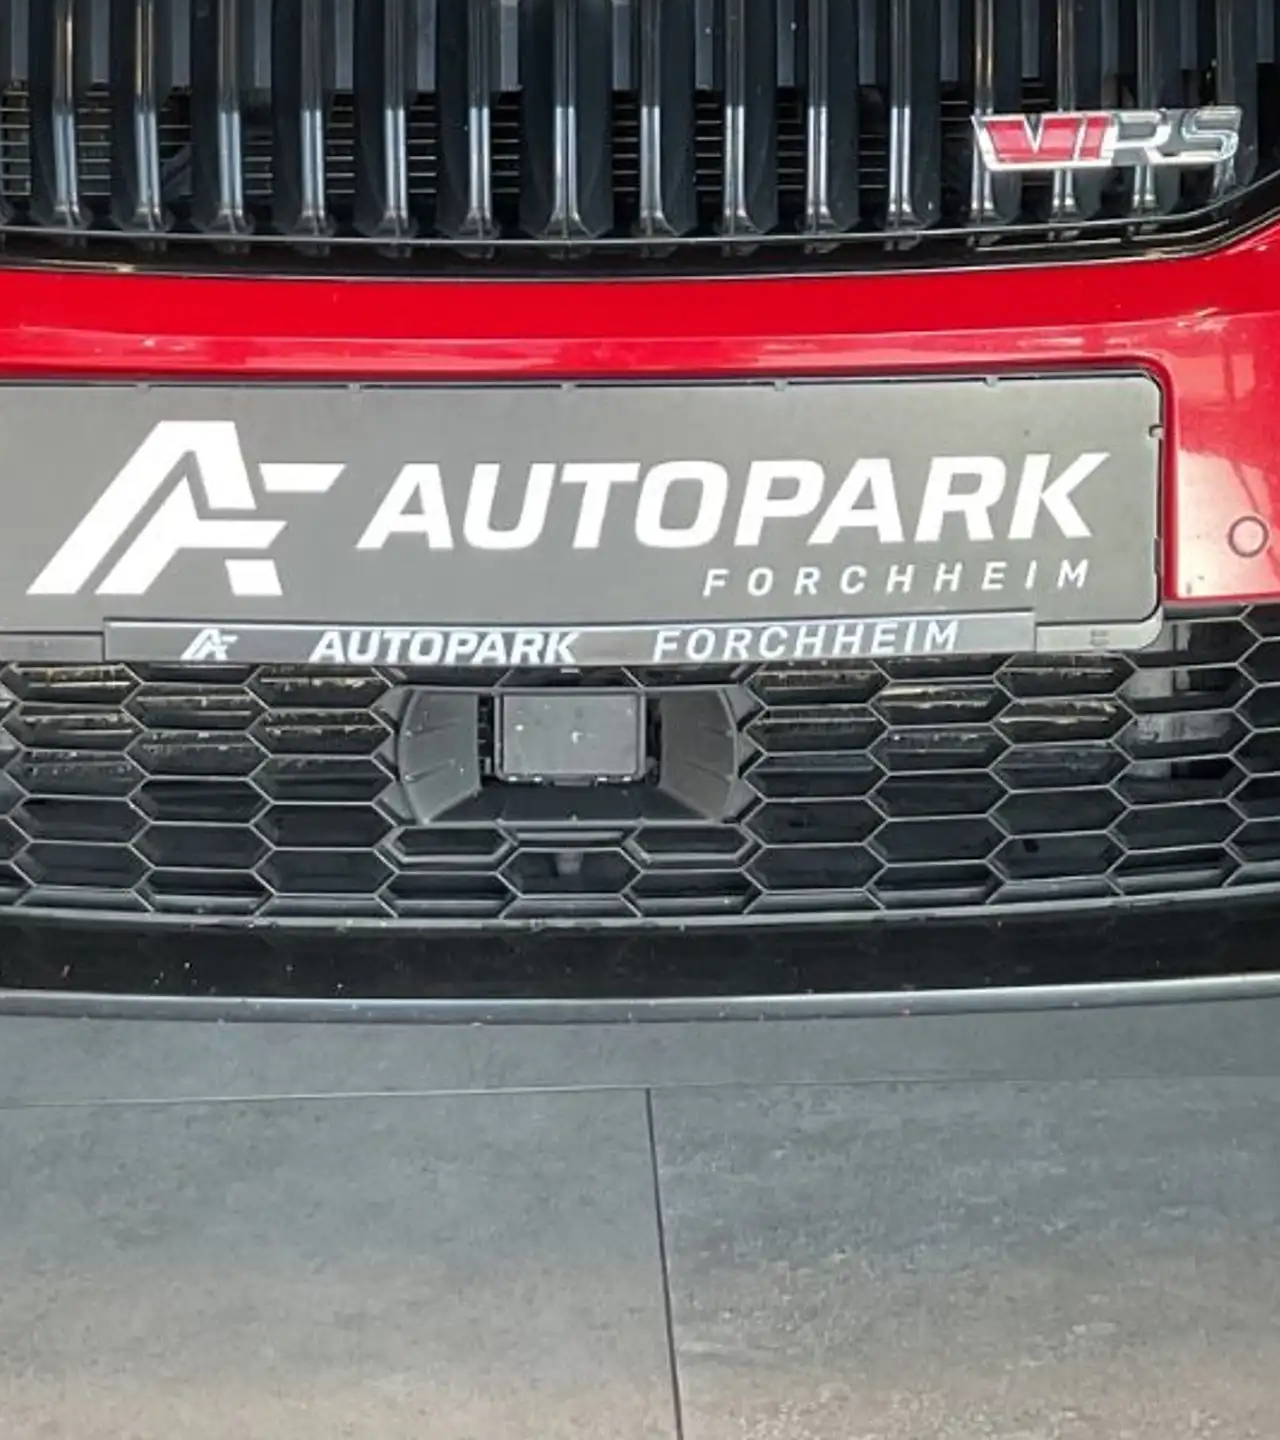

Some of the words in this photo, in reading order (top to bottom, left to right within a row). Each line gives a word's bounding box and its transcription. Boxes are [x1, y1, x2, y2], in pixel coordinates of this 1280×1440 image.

[354, 450, 1111, 551] AUTOPARK
[701, 557, 1092, 599] FORCHHEIM
[309, 629, 582, 667] AUTOPARK
[651, 619, 962, 662] FORCHHEIM
